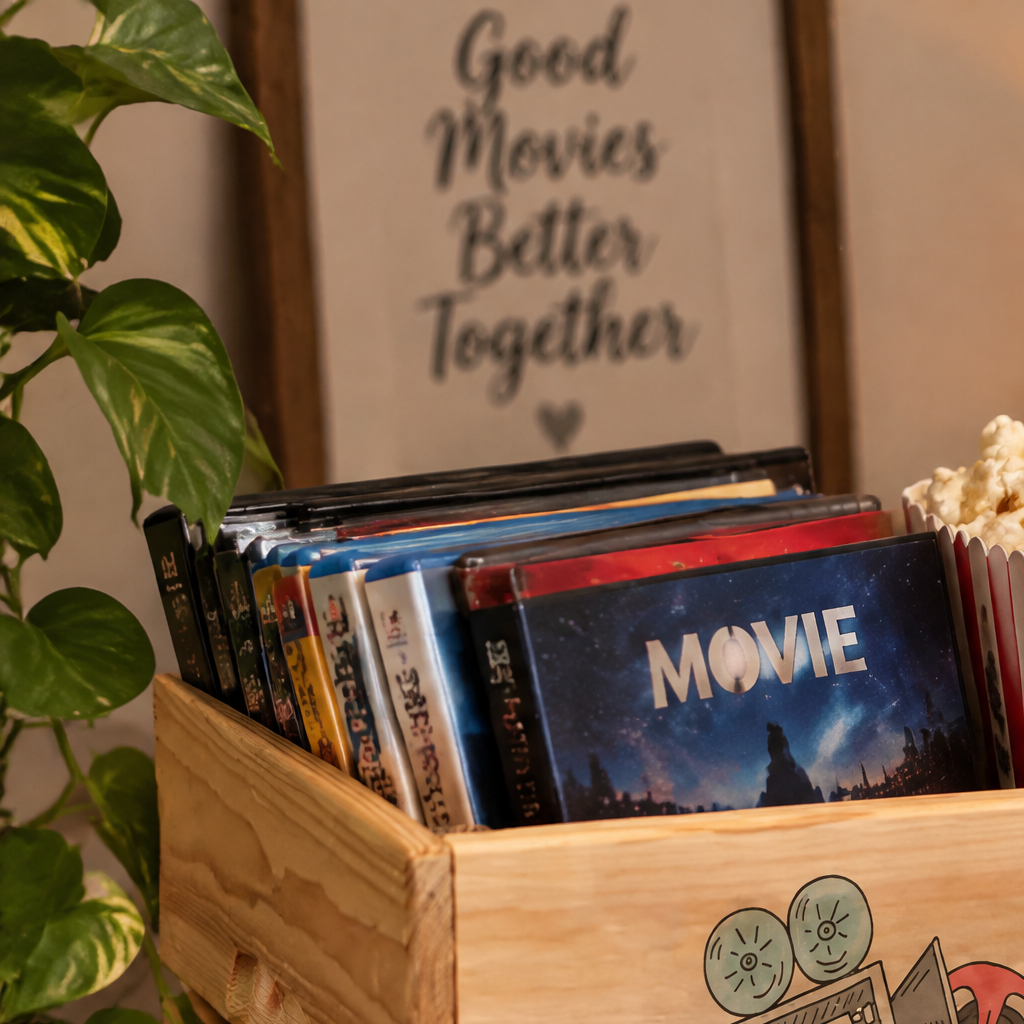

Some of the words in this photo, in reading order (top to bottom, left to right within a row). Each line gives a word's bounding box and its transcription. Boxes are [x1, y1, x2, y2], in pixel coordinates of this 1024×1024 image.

[452, 6, 637, 110] Good
[426, 102, 668, 193] Movies
[449, 195, 659, 289] Better
[416, 277, 700, 406] Together
[645, 605, 867, 709] MOVIE
